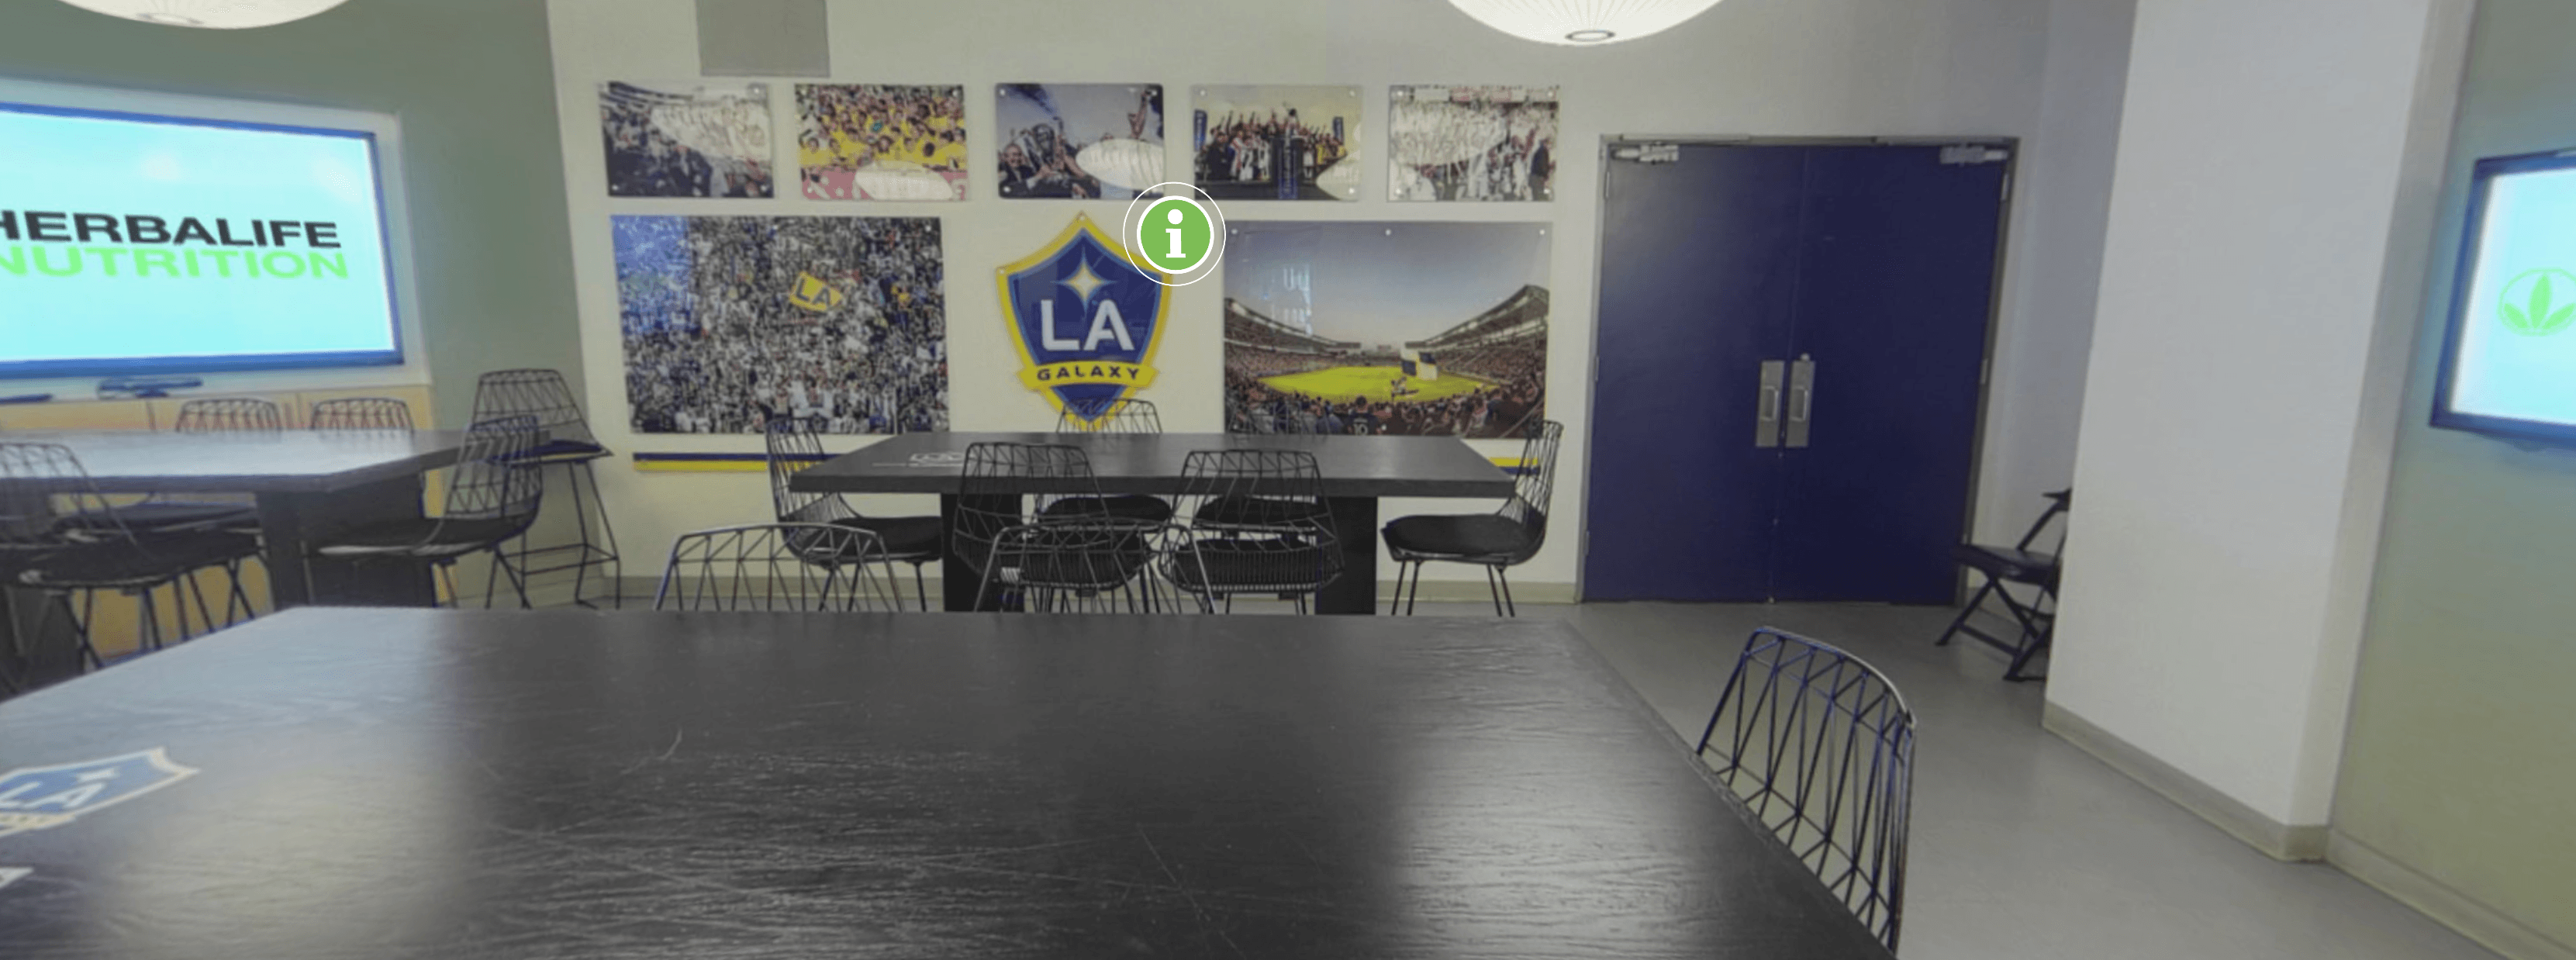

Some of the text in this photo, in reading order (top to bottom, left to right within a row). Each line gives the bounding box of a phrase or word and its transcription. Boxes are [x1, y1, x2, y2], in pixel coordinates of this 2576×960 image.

[0, 245, 349, 279] NUTRITION
[796, 277, 831, 306] LA
[1041, 299, 1134, 351] LA
[1037, 364, 1140, 381] GALAXY
[0, 780, 107, 808] LA
